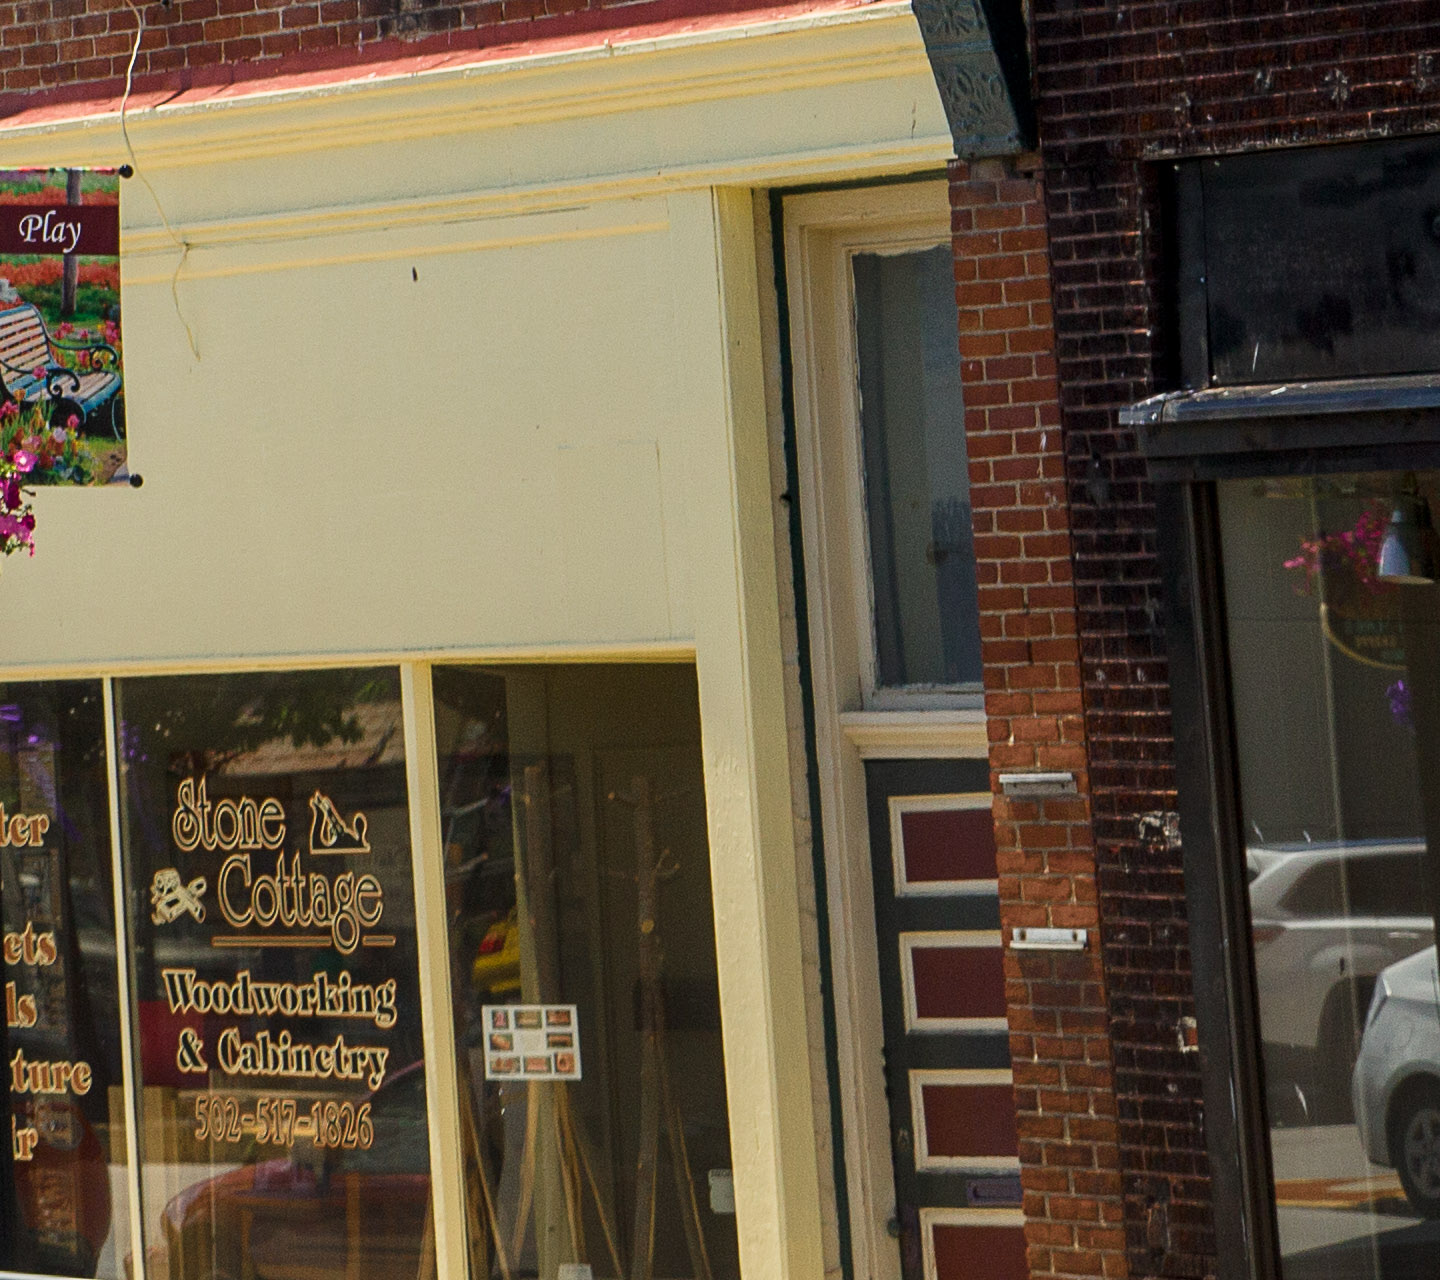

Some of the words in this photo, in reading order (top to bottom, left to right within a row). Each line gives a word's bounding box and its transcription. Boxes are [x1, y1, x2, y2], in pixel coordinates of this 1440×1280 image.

[18, 209, 82, 254] Play
[173, 774, 286, 852] Stone
[217, 849, 384, 955] Cottage
[161, 968, 398, 1029] Woodworking
[176, 1027, 209, 1074] &
[217, 1026, 390, 1092] Cabinetry
[194, 1095, 375, 1150] 502-517-1826
